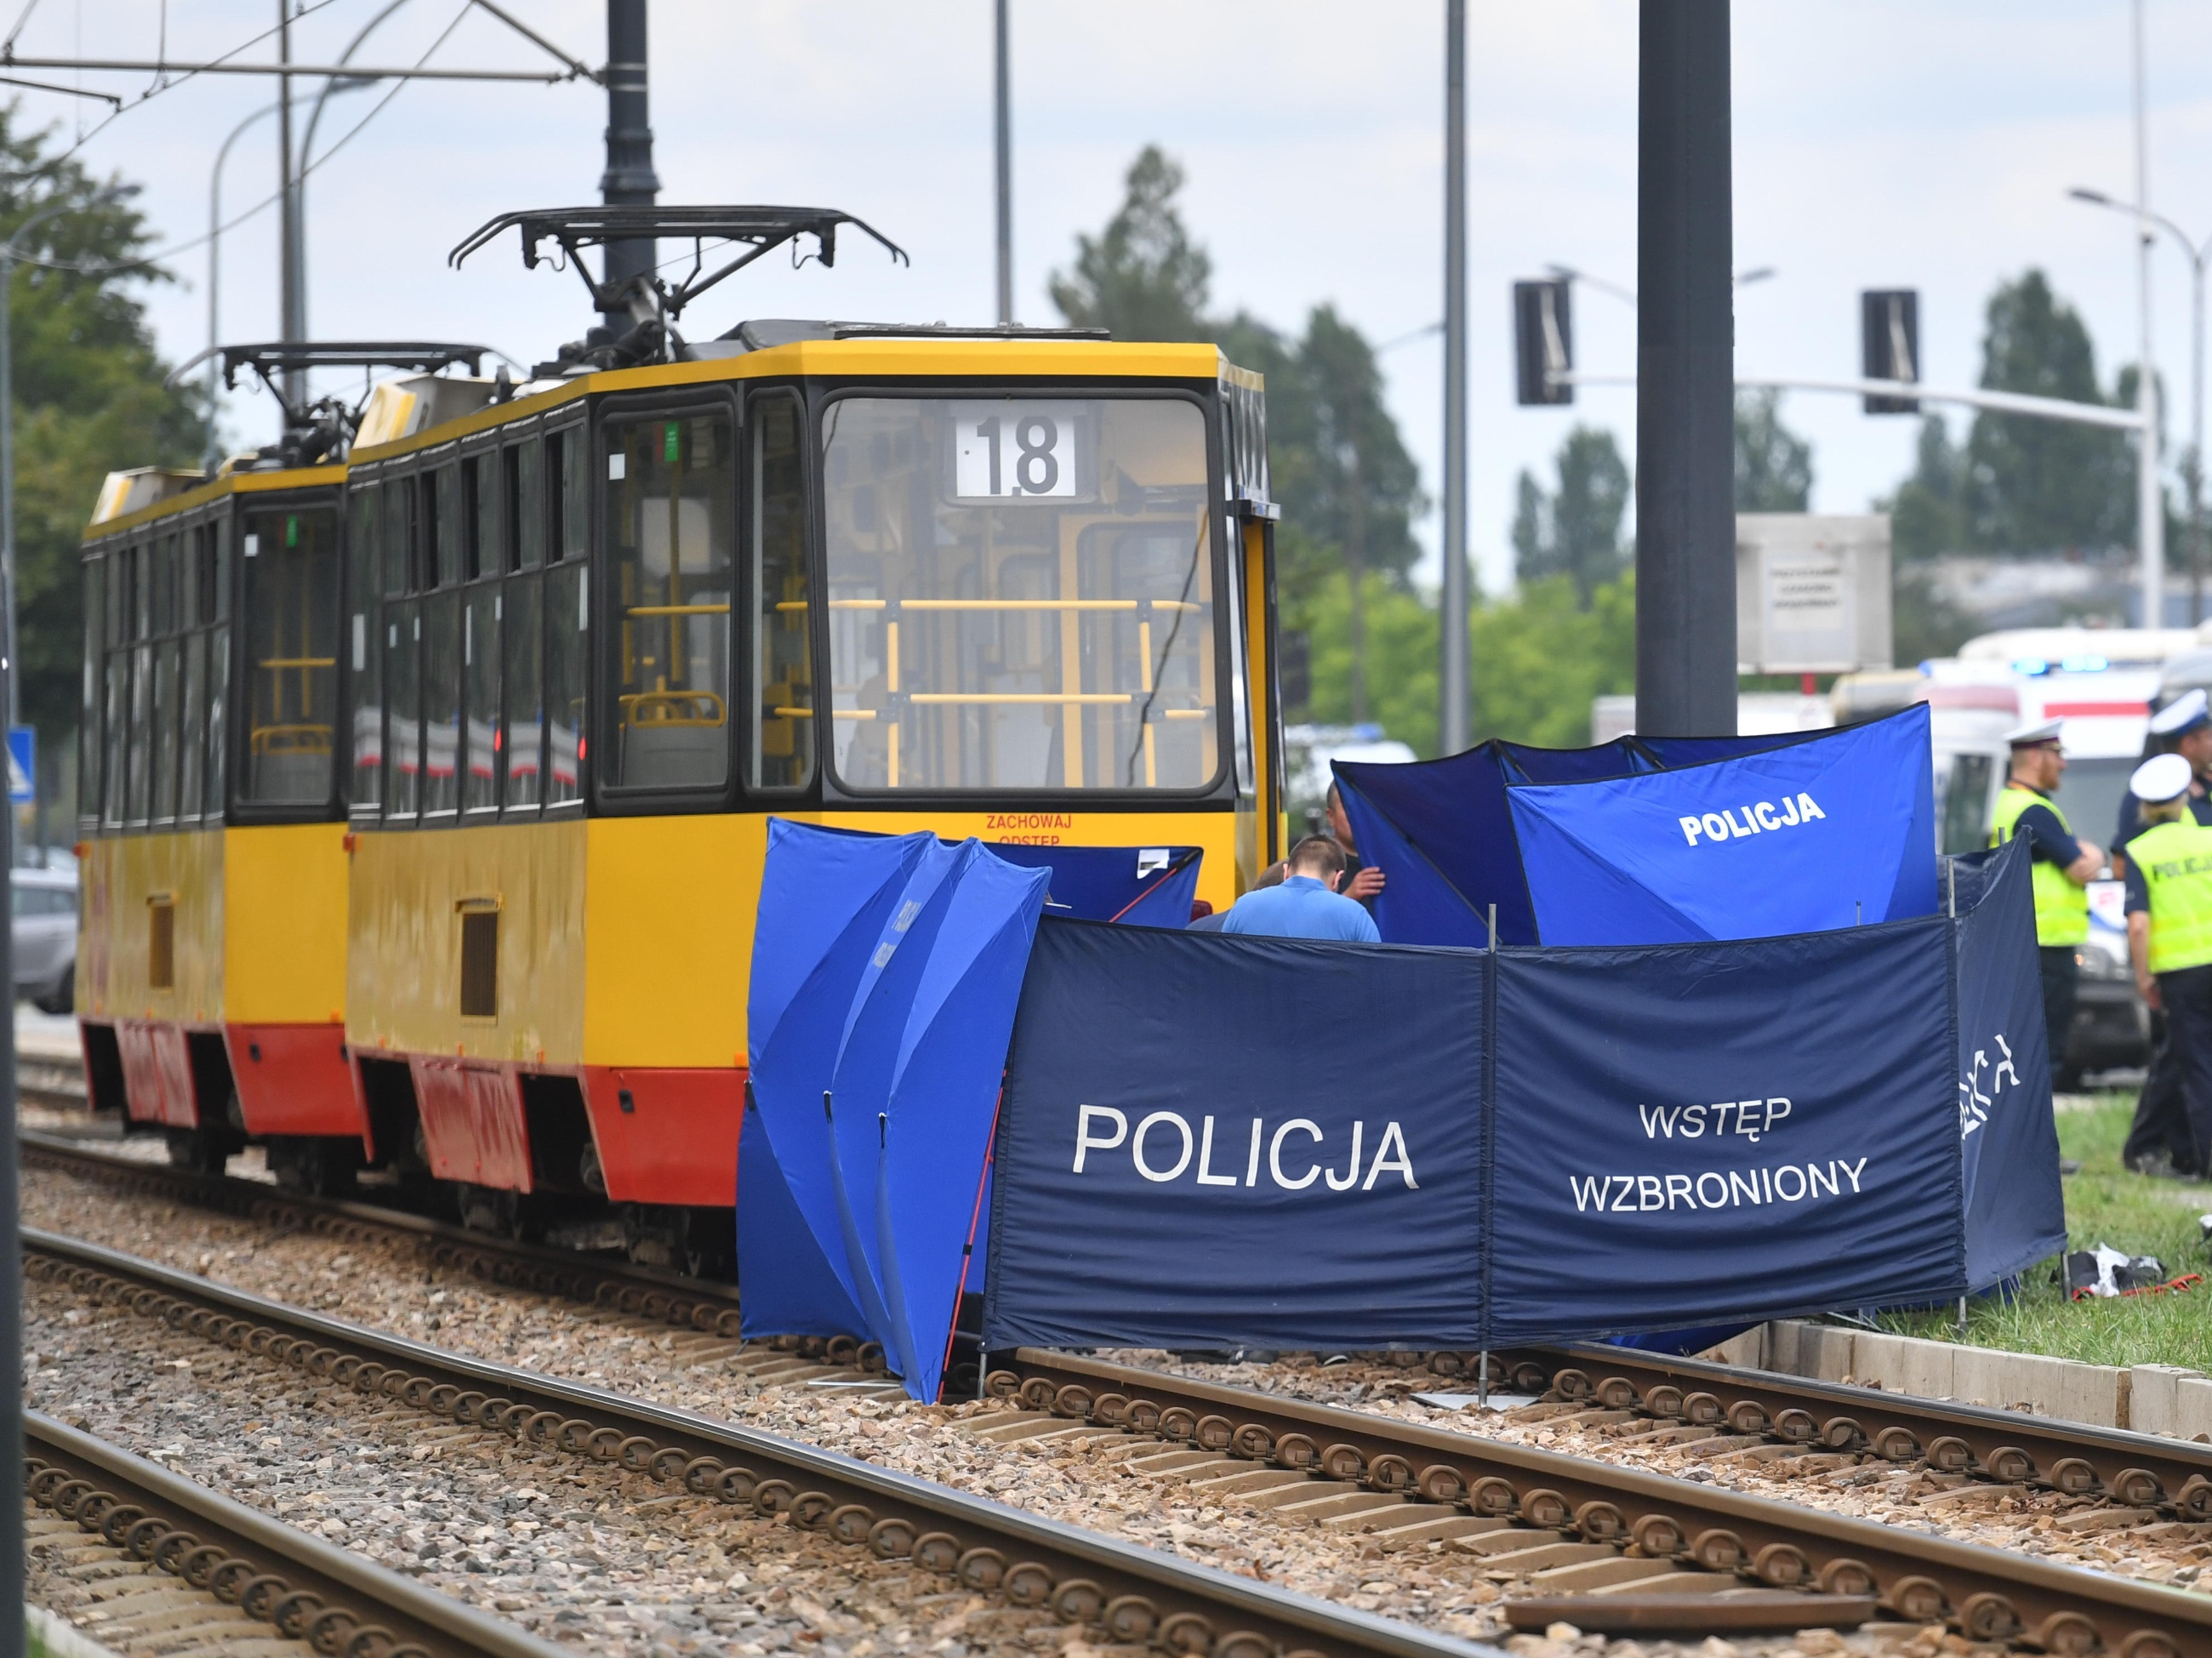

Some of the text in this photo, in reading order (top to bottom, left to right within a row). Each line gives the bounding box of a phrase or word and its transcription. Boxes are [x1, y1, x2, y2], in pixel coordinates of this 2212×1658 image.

[977, 416, 1058, 495] 18
[986, 814, 1072, 829] ZACHOWAJ
[1679, 792, 1827, 847] POLICJA
[1072, 1103, 1420, 1191] POLICJA
[1639, 1097, 1793, 1142] WSTĘP
[1570, 1157, 1868, 1212] WZBRONIONY
